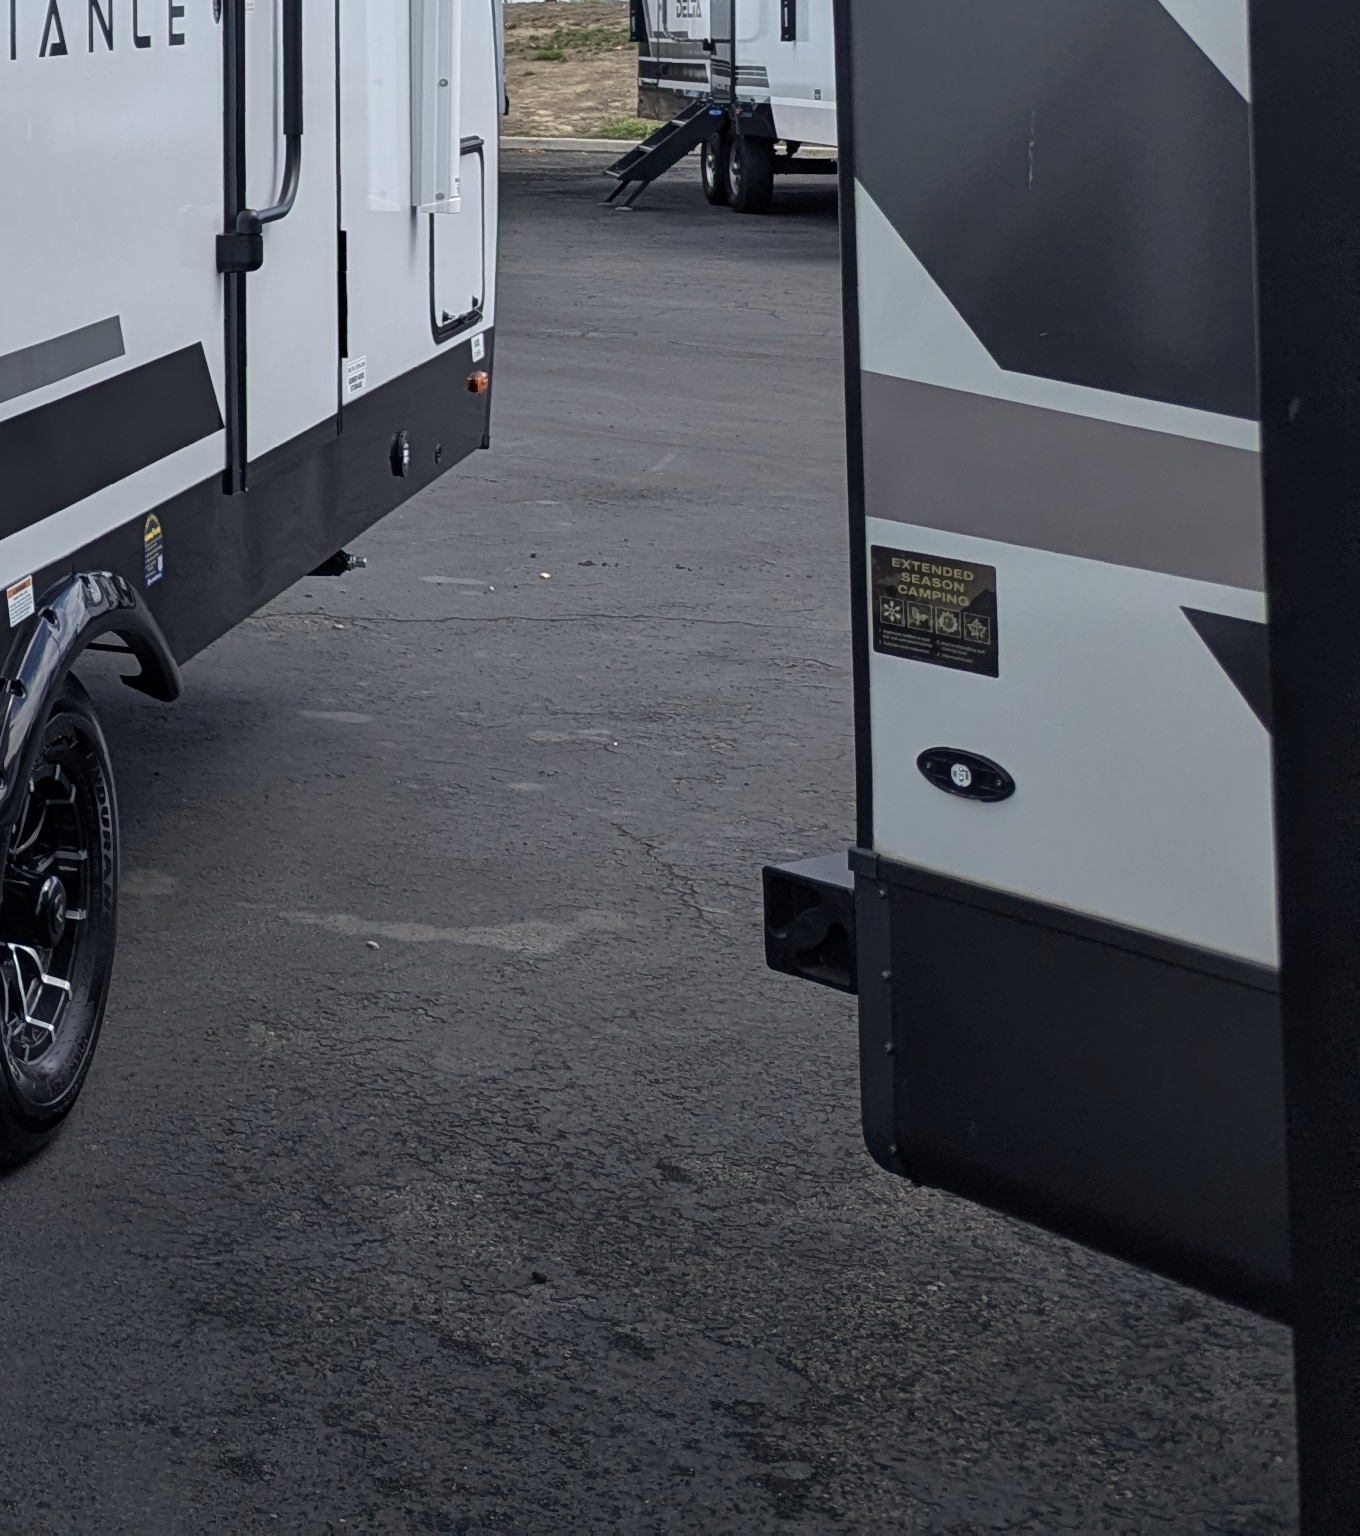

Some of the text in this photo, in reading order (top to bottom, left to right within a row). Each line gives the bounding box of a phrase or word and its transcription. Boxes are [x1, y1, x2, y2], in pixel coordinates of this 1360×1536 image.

[892, 557, 974, 581] EXTENDED
[900, 572, 965, 593] SEASON
[897, 585, 970, 607] CAMPING
